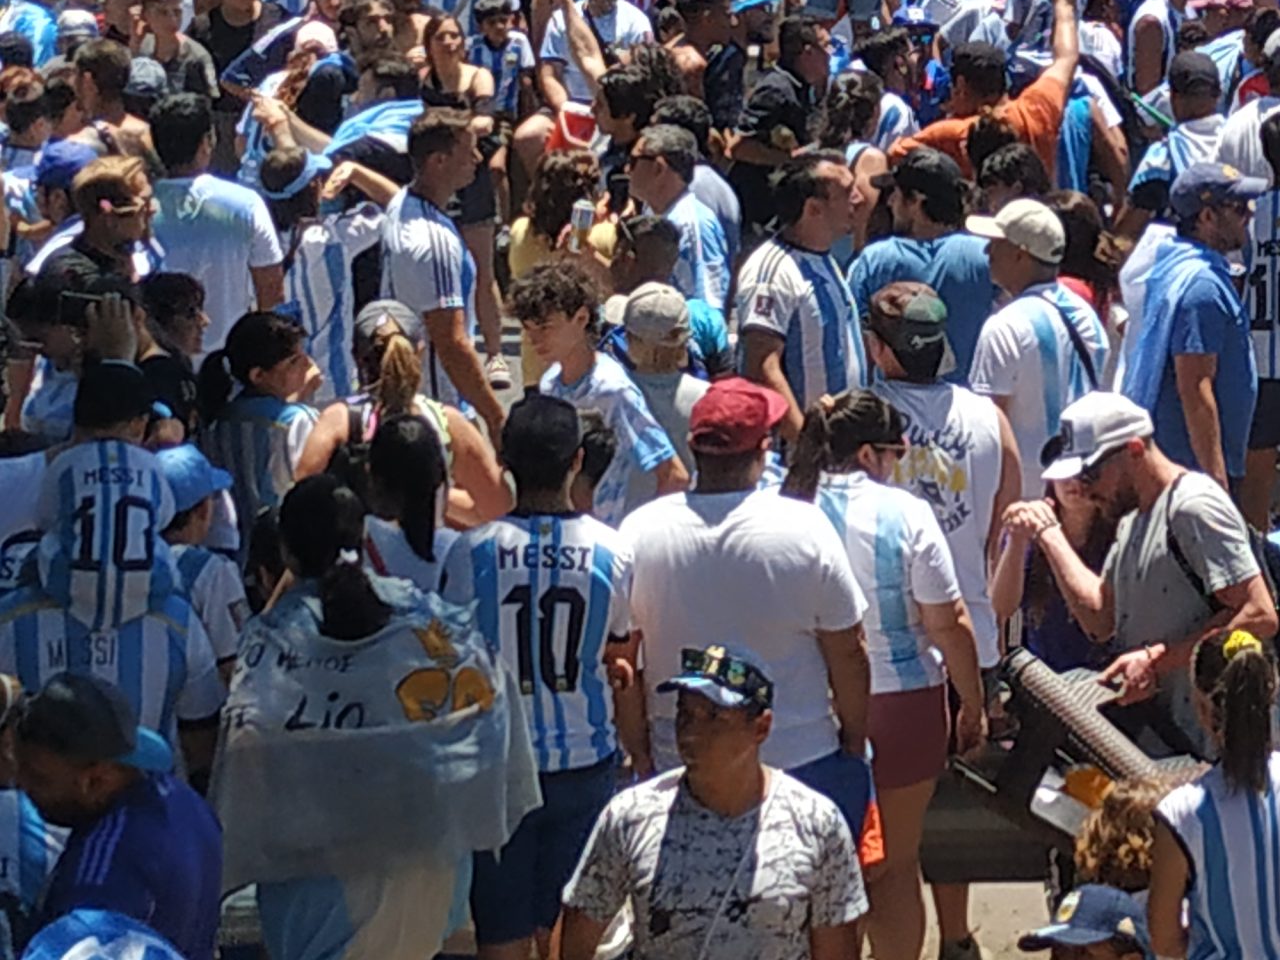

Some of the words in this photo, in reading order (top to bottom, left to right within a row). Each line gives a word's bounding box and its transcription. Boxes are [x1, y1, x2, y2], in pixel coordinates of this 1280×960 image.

[84, 468, 144, 486] MESSI
[71, 495, 154, 571] 10
[498, 543, 591, 573] MESSI
[47, 634, 117, 667] MSSI
[501, 584, 585, 695] 10
